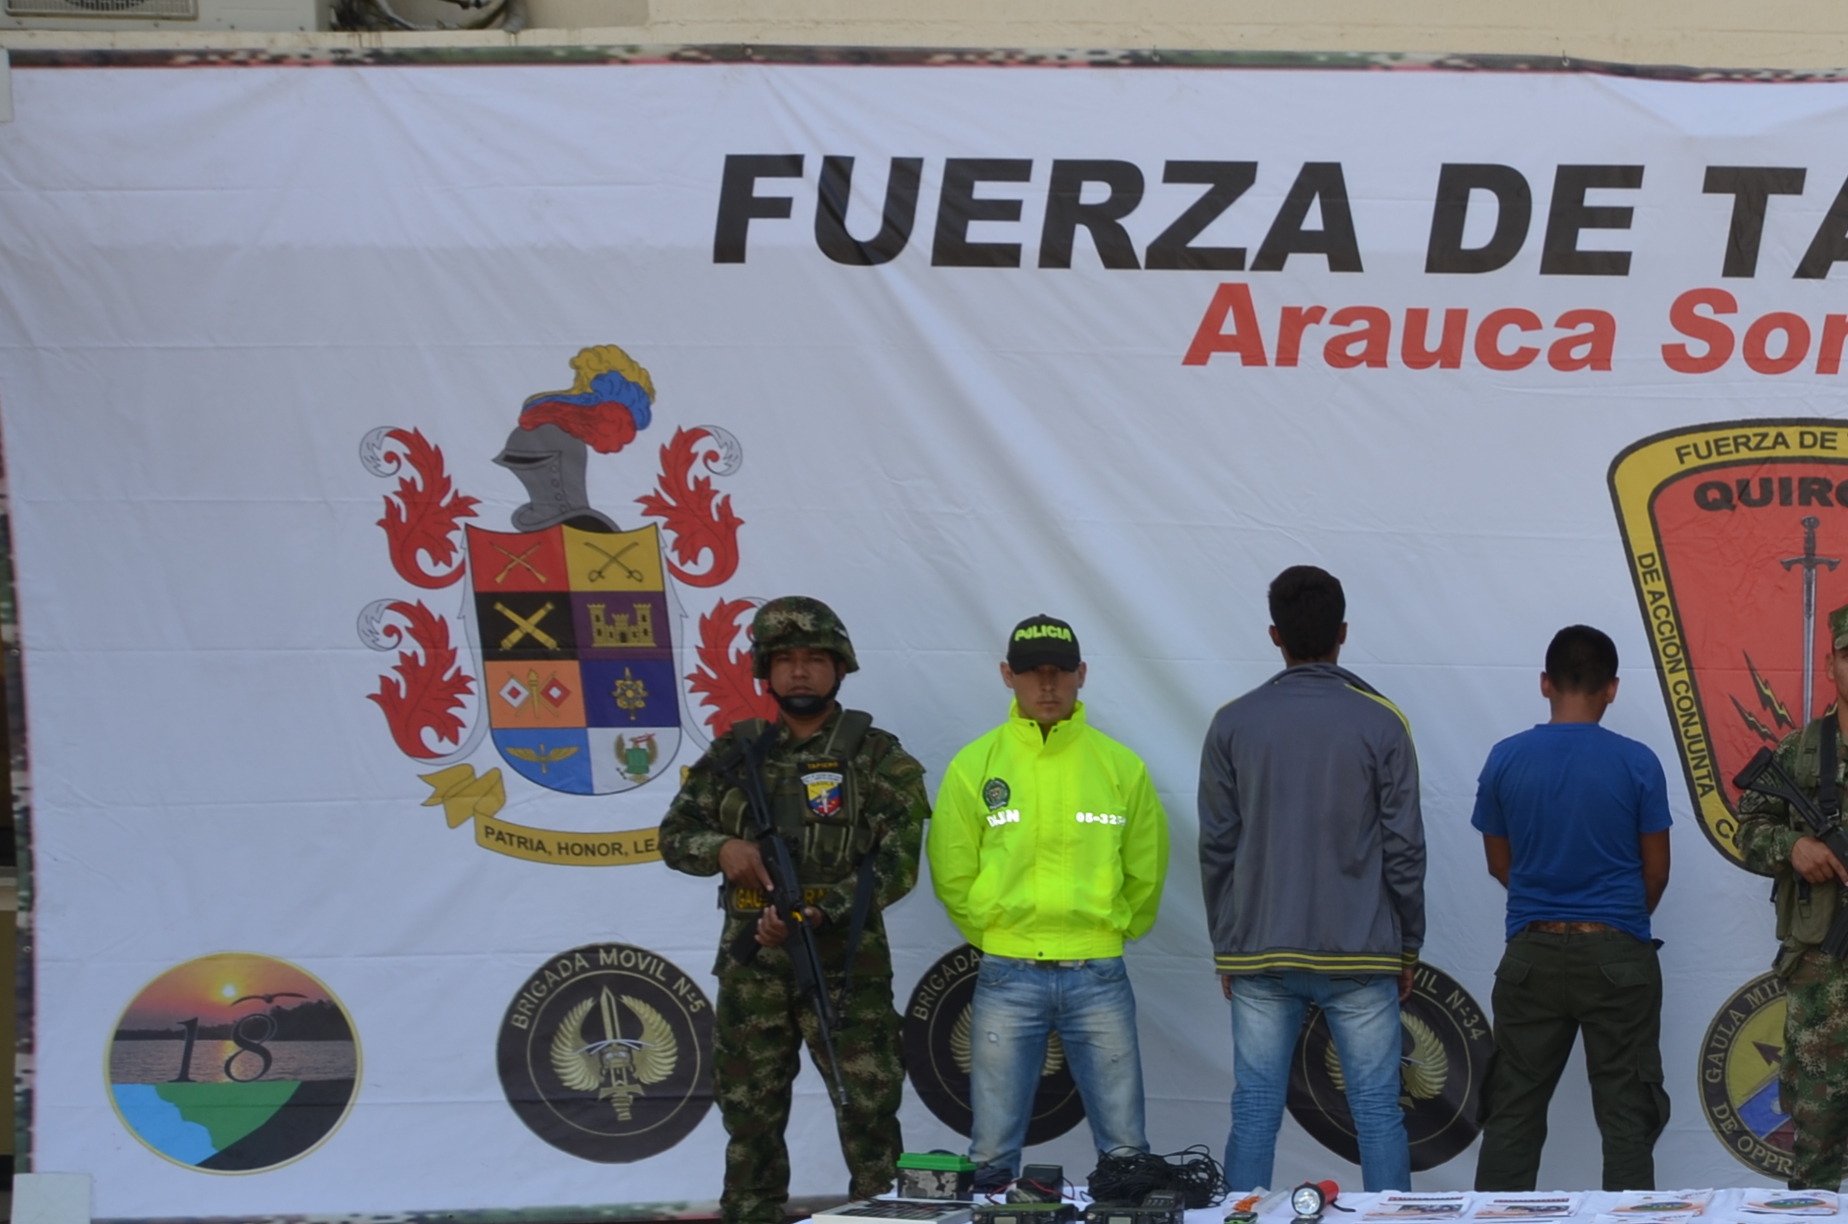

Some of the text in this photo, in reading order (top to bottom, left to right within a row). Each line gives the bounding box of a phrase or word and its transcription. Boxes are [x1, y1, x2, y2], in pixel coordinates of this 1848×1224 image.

[713, 153, 1365, 273] FUERZA
[1424, 162, 1646, 277] DE
[1180, 282, 1618, 373] Arauca
[1674, 430, 1791, 465] FUERZA
[1798, 430, 1838, 451] DE
[1013, 624, 1073, 643] POLICIA
[1637, 552, 1715, 799] DE ACCIÓN CONJUNTA
[483, 824, 662, 858] PATRIA, HONOR, LE
[511, 952, 590, 1030] BRIGADA
[599, 947, 667, 982] MOVIL
[912, 948, 981, 1021] BRIGADA
[166, 1013, 278, 1084] 18
[1705, 1008, 1746, 1084] GAULA
[1712, 1101, 1738, 1135] DE
